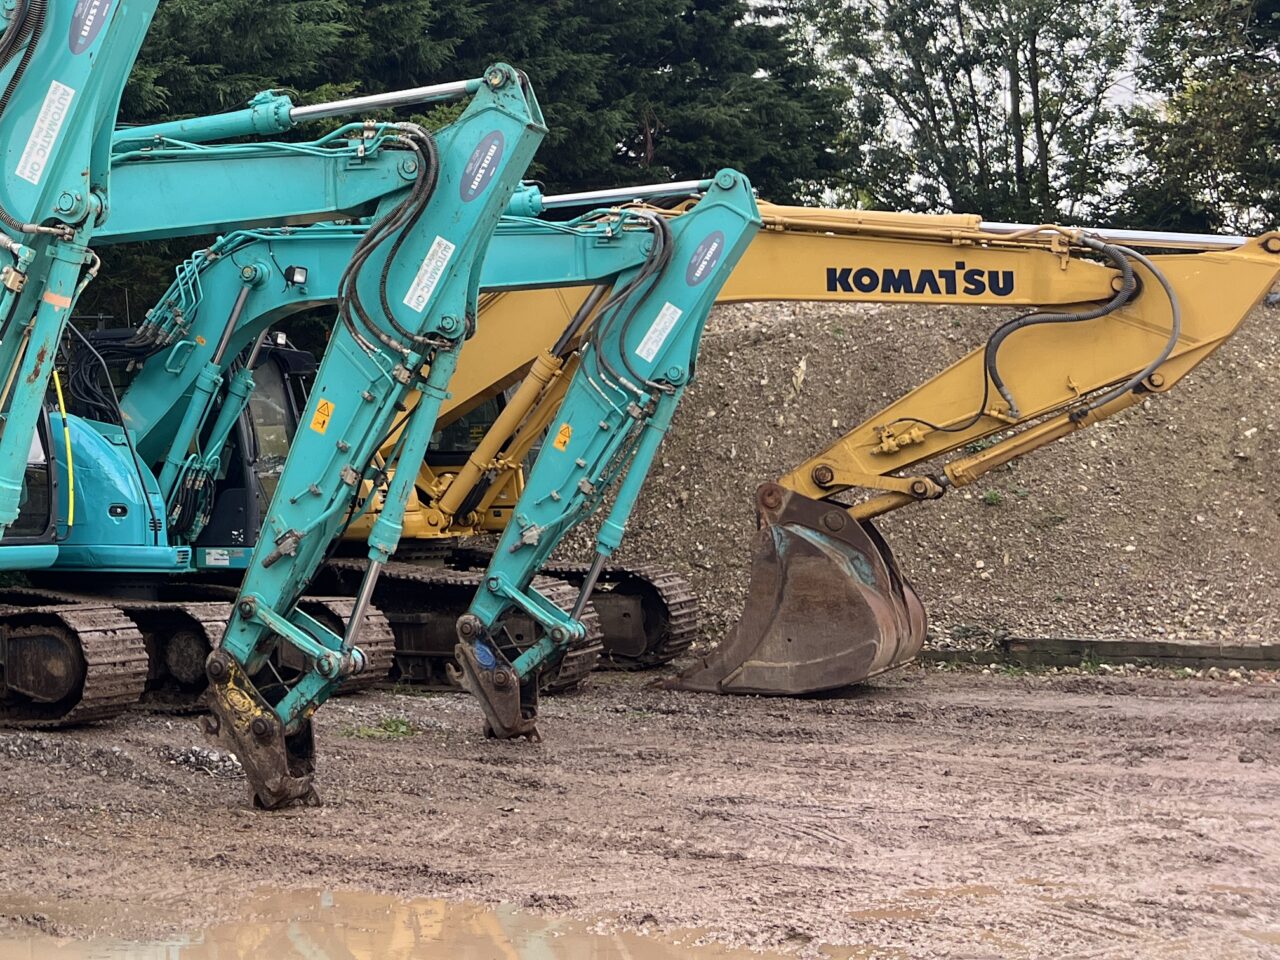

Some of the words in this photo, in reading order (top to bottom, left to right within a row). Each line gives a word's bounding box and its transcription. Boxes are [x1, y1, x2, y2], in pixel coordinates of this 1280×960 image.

[35, 87, 72, 158] AUTOMATIC
[38, 96, 56, 124] Safety
[25, 160, 41, 181] QH
[420, 243, 452, 293] AUTOMATIC
[826, 261, 1014, 296] KOMATSU
[412, 294, 425, 310] QH
